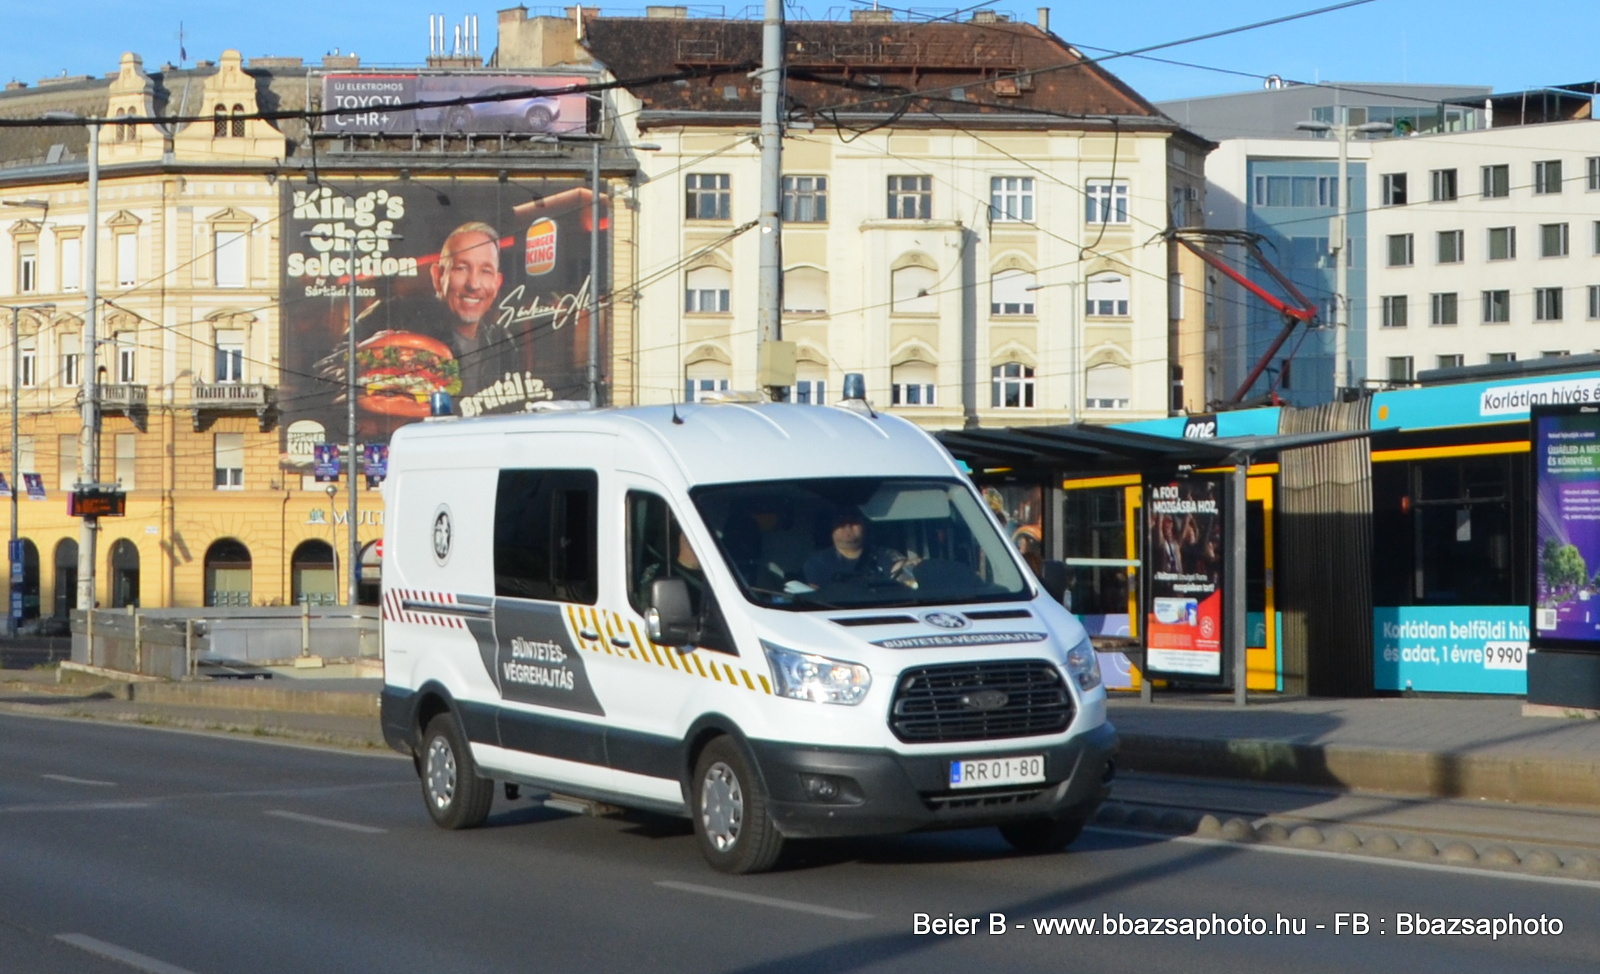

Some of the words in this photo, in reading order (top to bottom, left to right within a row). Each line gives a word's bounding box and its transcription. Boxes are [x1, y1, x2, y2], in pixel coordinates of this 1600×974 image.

[334, 81, 345, 91] ÚJ
[346, 82, 404, 91] ELEKTROMOS
[334, 95, 402, 109] TOYOTA
[334, 112, 390, 126] C-HR+
[309, 220, 394, 252] Chef
[287, 251, 418, 277] Selection
[526, 246, 555, 265] KING
[347, 286, 377, 297] kos
[459, 371, 526, 418] Brutál
[1484, 389, 1548, 411] Korlátlan
[1551, 385, 1590, 405] hívás
[286, 433, 326, 443] BURGER
[1184, 421, 1216, 439] one
[286, 442, 315, 455] KIN
[1547, 455, 1557, 466] ÉS
[1152, 487, 1160, 499] A
[1152, 498, 1197, 513] MOZGÁSBA
[1197, 500, 1219, 515] HOZ,
[1383, 620, 1448, 639] Korlátlan
[1450, 620, 1507, 639] belföldi
[511, 636, 568, 663] BÜNTETÉS-
[1383, 644, 1400, 662] és
[1402, 644, 1441, 665] adat,
[1442, 646, 1449, 662] 1
[1451, 644, 1483, 663] évre
[1486, 647, 1494, 663] 9
[1497, 647, 1523, 664] 990
[503, 659, 575, 690] VÉGREHAJTÁS
